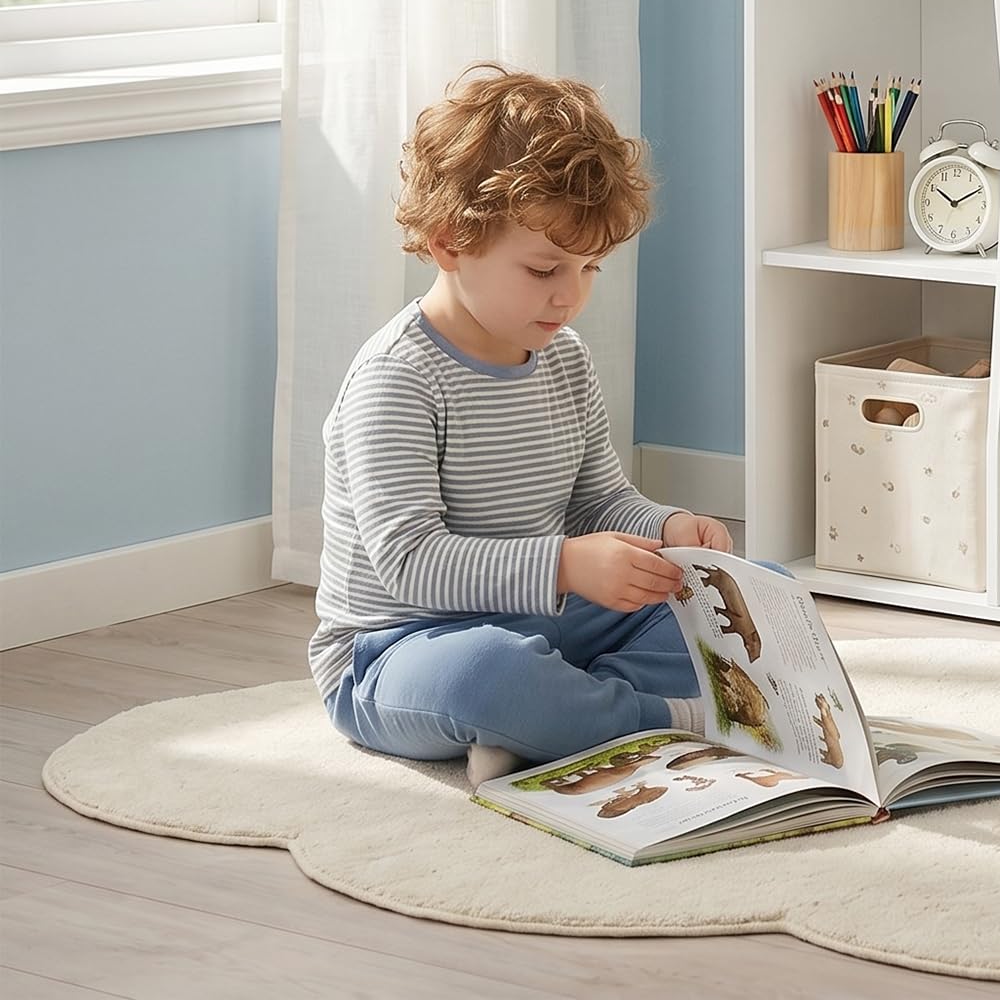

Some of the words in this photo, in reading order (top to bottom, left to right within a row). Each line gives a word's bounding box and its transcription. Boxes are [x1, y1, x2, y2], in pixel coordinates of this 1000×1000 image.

[941, 172, 947, 181] 11
[953, 169, 961, 177] 12
[981, 201, 986, 209] 3
[976, 216, 981, 224] 4
[938, 225, 943, 233] 7
[950, 230, 956, 239] 6
